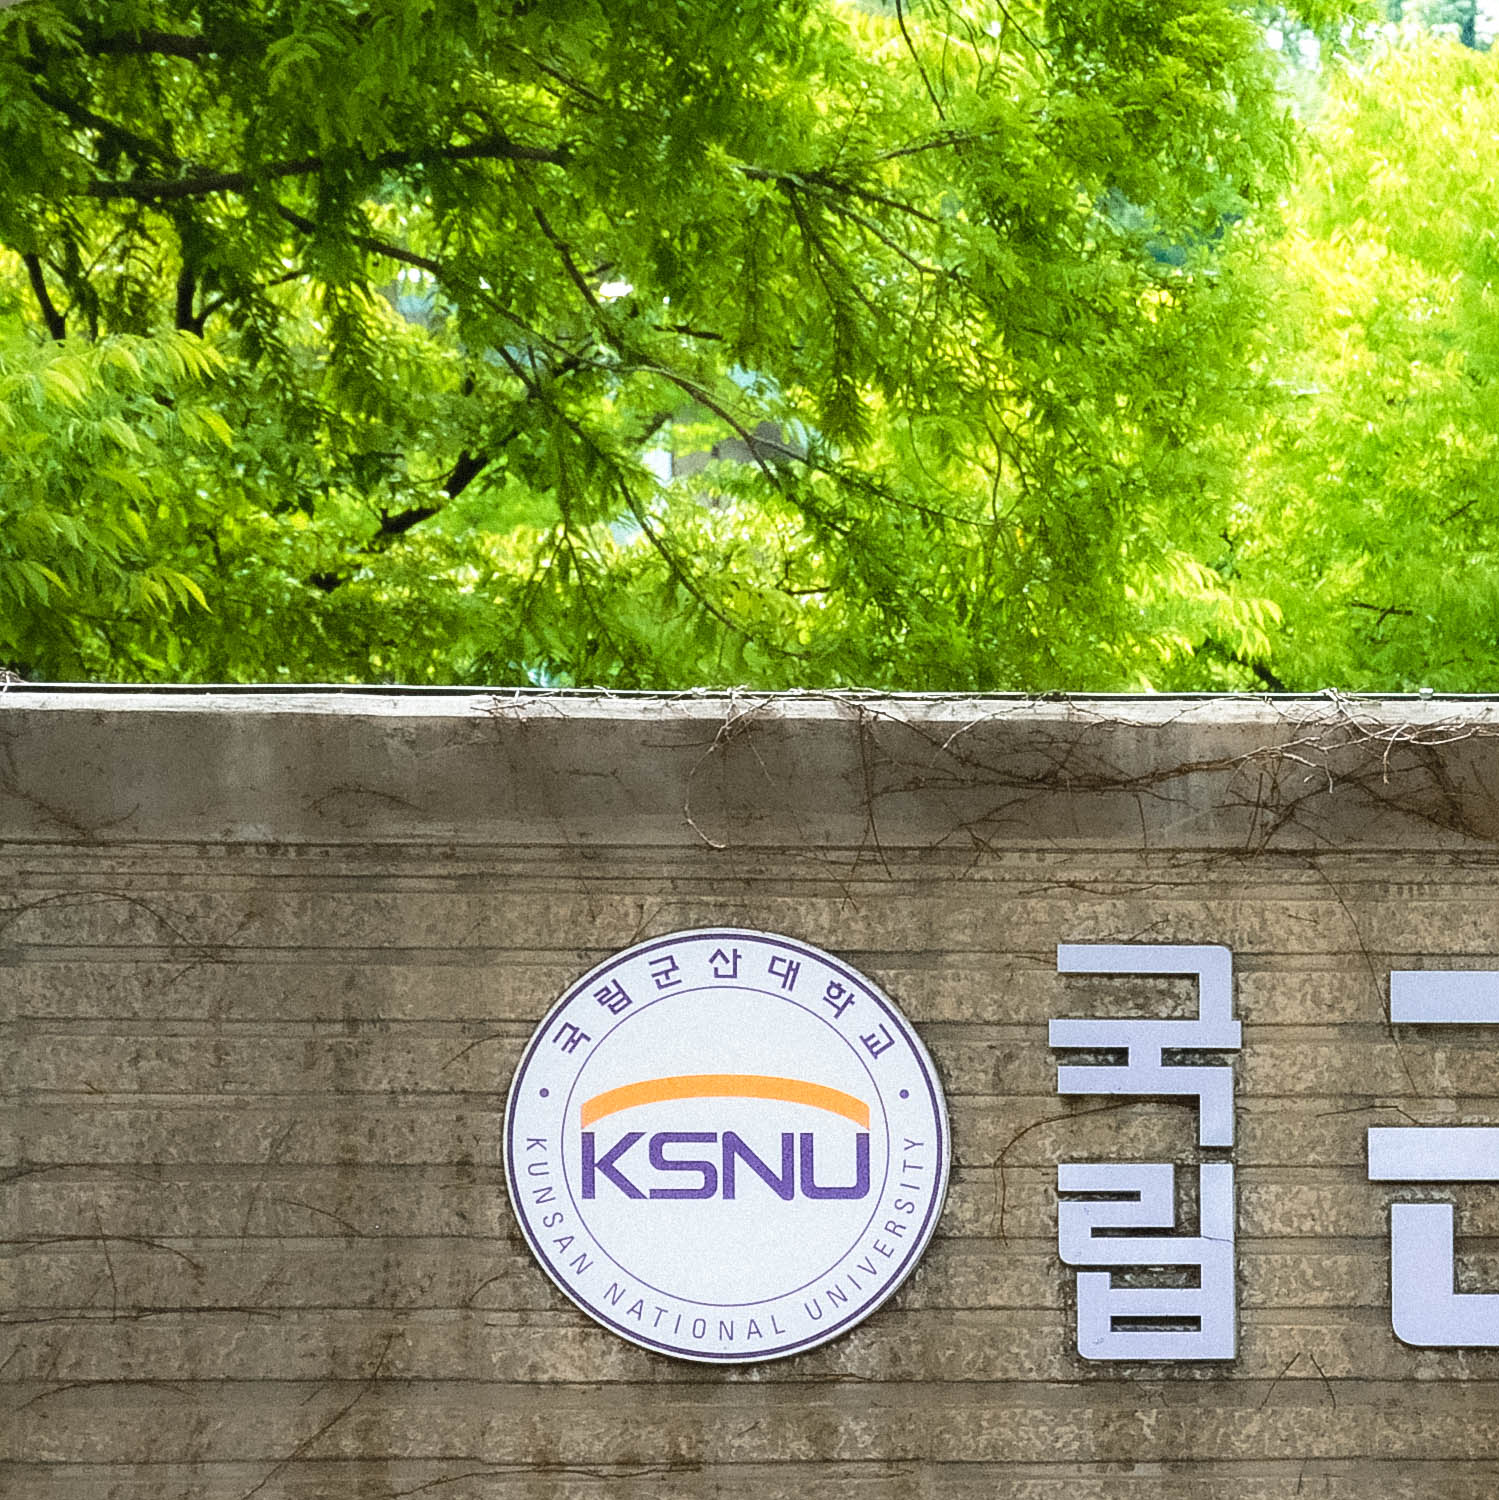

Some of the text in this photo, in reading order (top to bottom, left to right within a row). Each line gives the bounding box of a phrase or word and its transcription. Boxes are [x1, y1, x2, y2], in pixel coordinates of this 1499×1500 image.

[551, 947, 895, 1061] 국립군산대학교
[581, 1130, 871, 1201] KSNU
[1049, 943, 1242, 1361] 국립
[526, 1136, 925, 1342] KUNSAN NATIONAL UNIVERSITY
